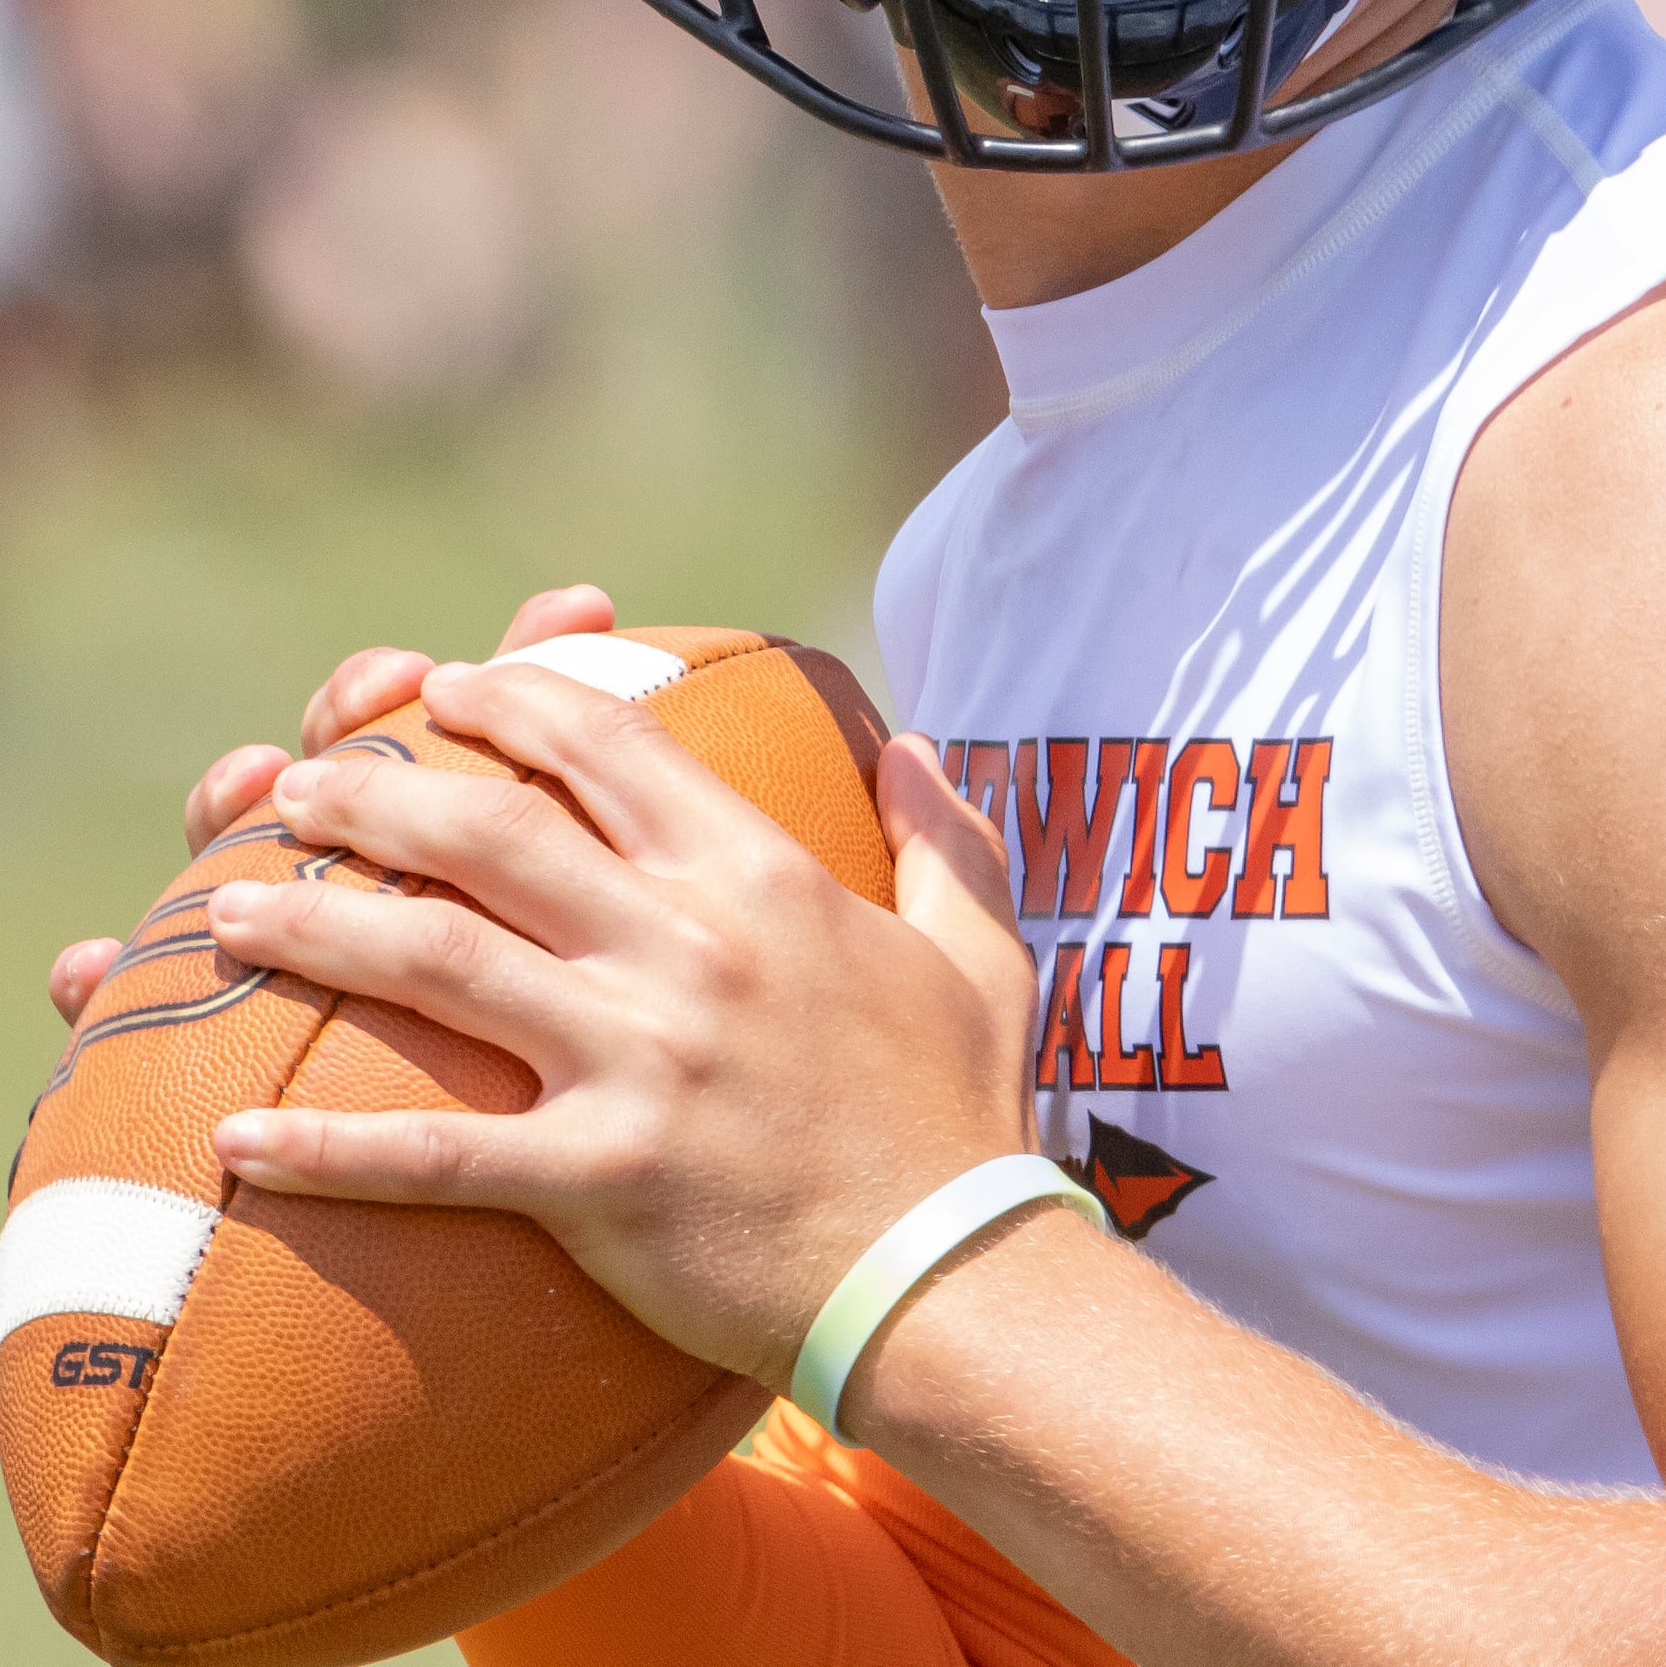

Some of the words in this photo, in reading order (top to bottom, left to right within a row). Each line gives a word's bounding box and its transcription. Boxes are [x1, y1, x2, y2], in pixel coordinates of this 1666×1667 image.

[933, 736, 1335, 921] WICH
[1027, 941, 1230, 1092] ALL
[51, 1340, 159, 1389] GST
